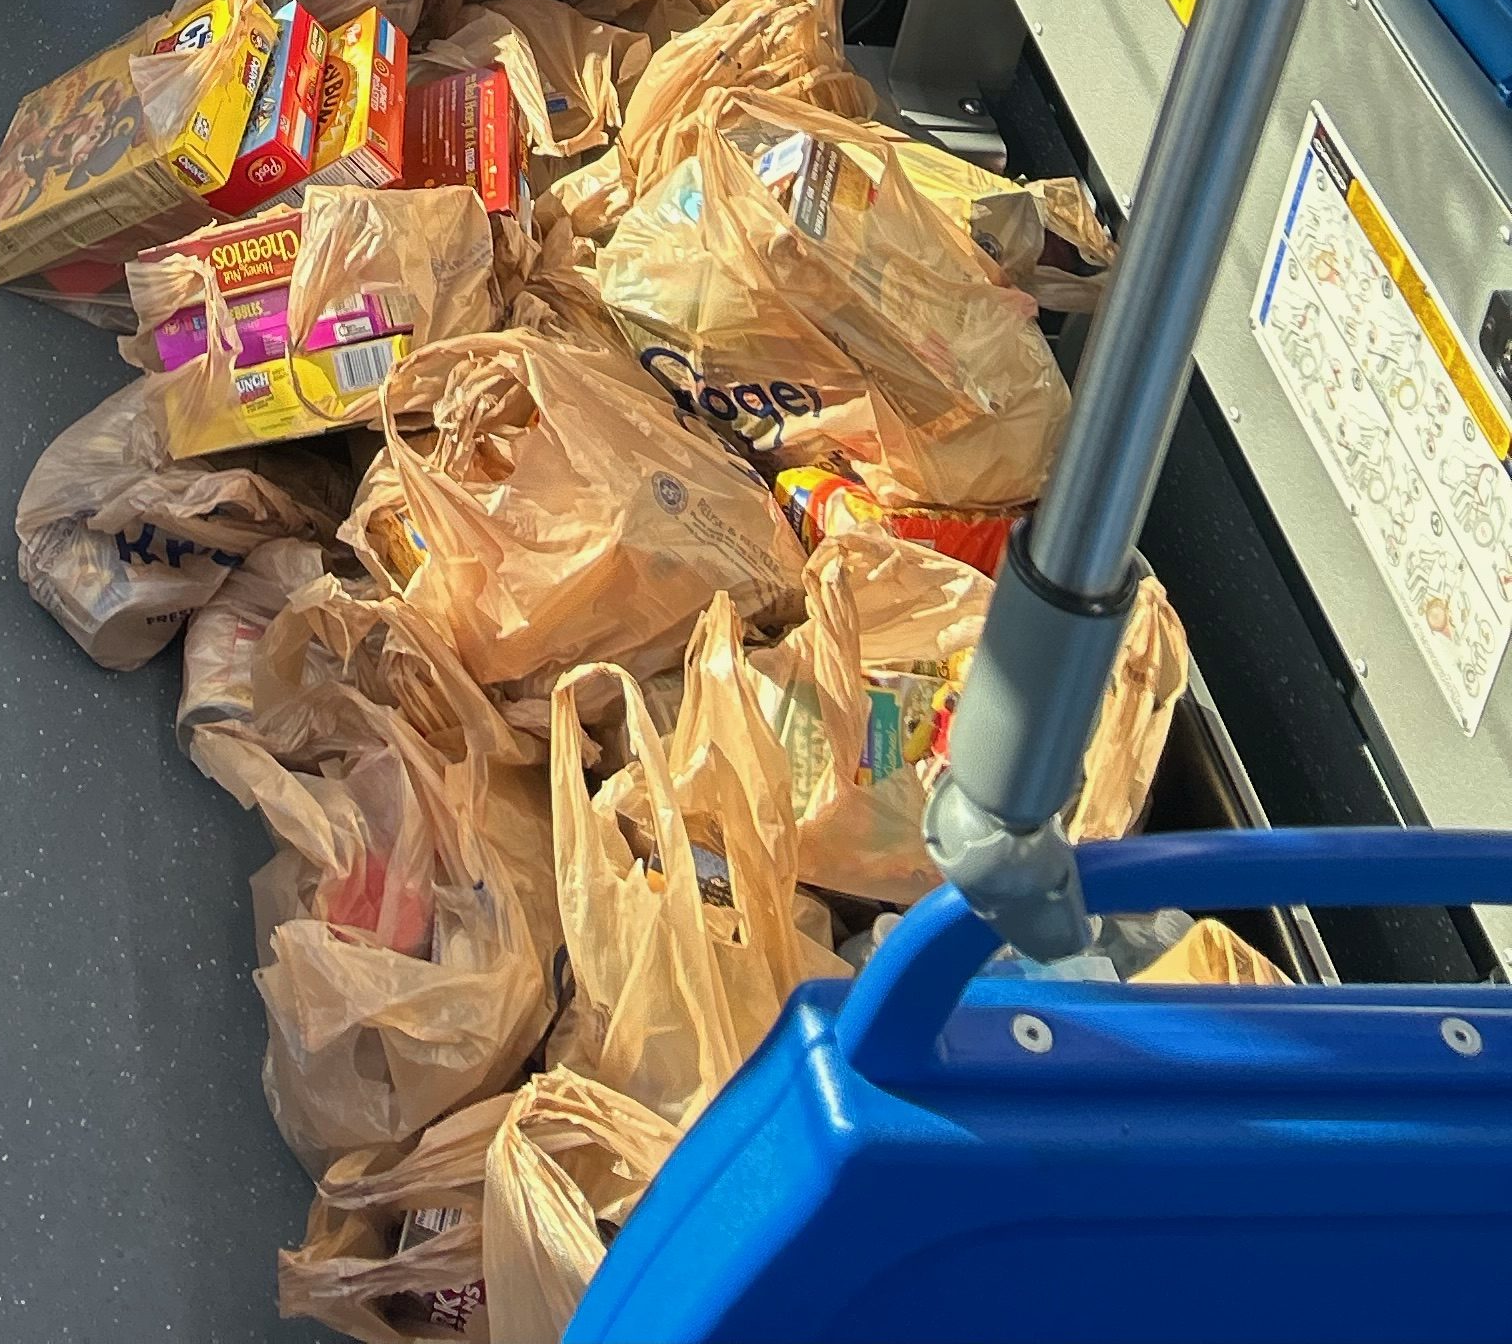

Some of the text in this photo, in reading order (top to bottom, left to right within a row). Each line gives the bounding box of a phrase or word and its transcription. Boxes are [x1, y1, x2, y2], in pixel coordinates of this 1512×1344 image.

[253, 157, 284, 182] Post
[211, 229, 300, 270] Cheerios
[223, 260, 274, 285] Honey Nut
[235, 371, 271, 393] UNCH
